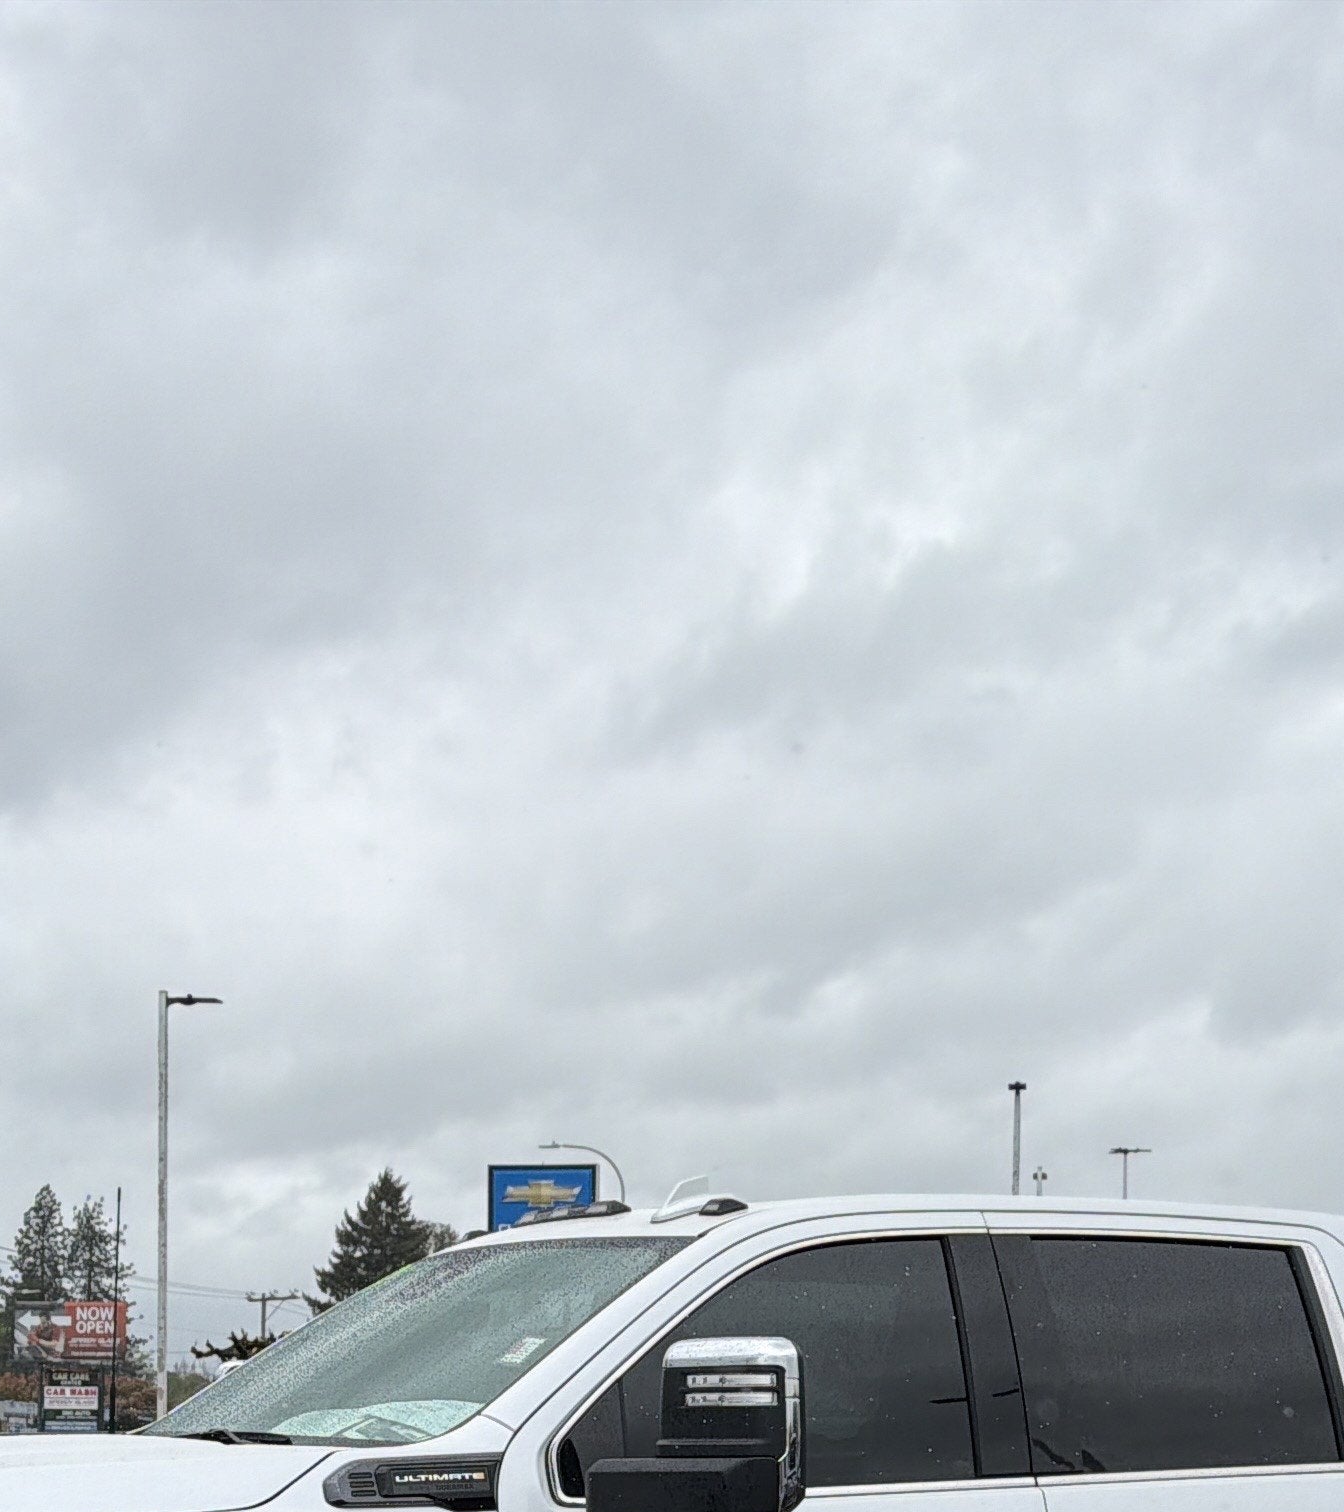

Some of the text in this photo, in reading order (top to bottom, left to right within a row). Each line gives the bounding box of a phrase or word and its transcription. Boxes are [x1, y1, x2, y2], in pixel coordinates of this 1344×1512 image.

[76, 1306, 114, 1320] NOW
[76, 1321, 115, 1334] OPEN
[46, 1388, 97, 1396] CAR WASH
[395, 1472, 485, 1483] ULTIMATE
